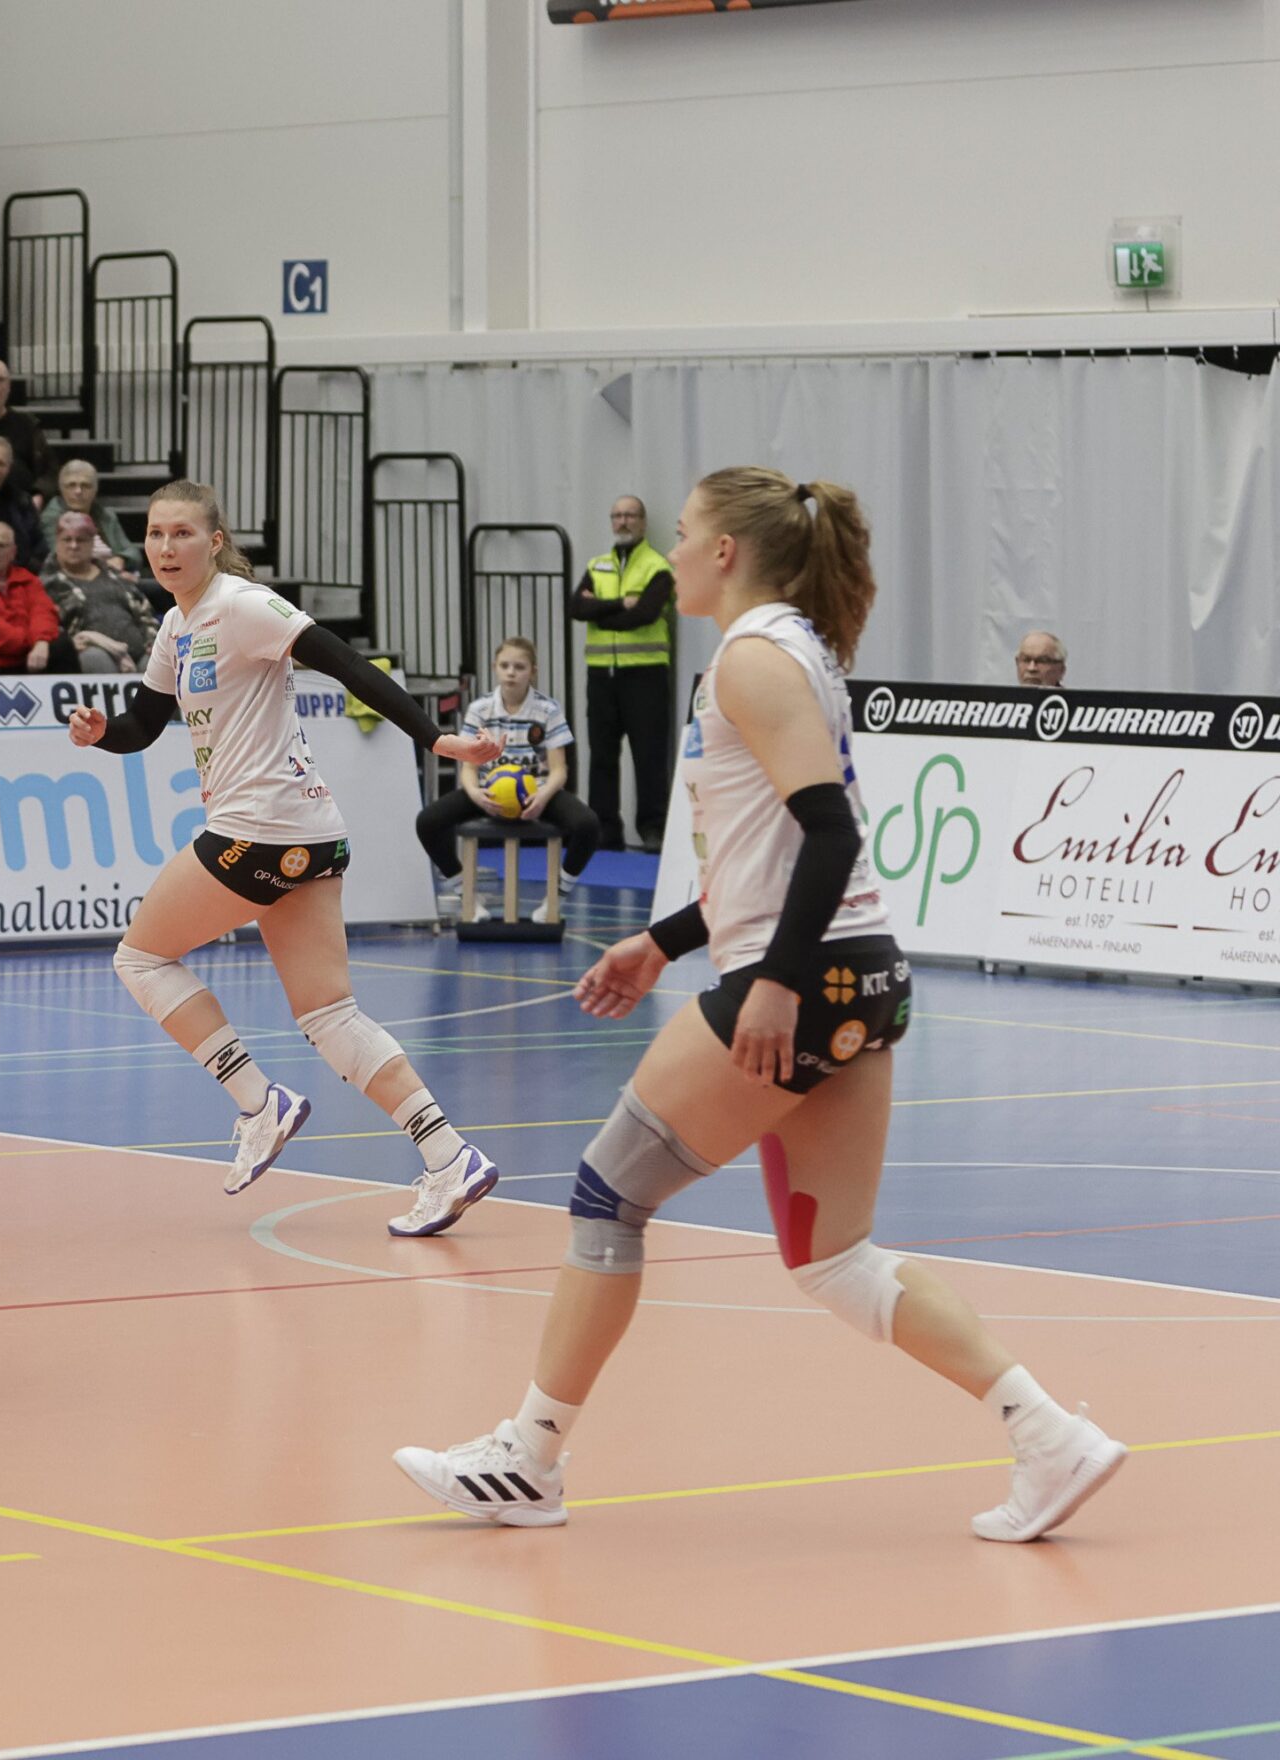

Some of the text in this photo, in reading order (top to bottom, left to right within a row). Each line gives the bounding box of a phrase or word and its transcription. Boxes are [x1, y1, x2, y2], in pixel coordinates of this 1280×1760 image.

[289, 262, 322, 311] C1
[192, 666, 209, 678] Go
[195, 676, 213, 688] On
[894, 698, 1215, 737] WARRIOR WARRIOR
[1013, 766, 1190, 868] Emilia
[254, 869, 271, 882] OP
[1036, 874, 1154, 904] HOTELLI
